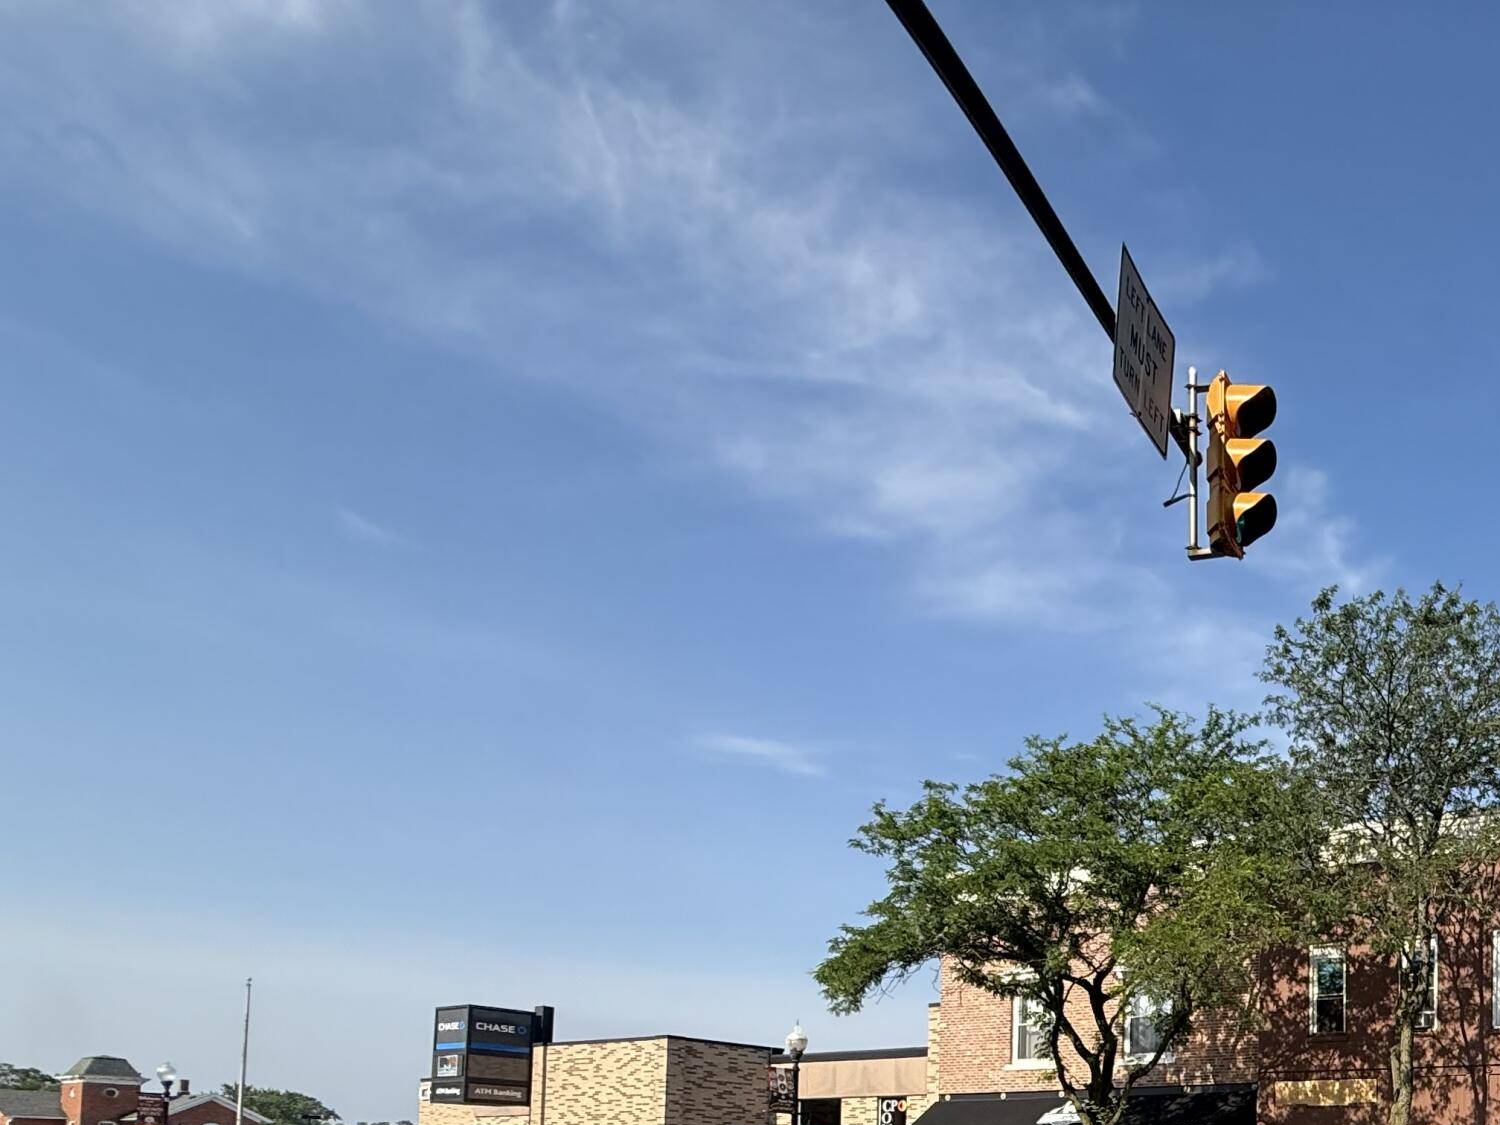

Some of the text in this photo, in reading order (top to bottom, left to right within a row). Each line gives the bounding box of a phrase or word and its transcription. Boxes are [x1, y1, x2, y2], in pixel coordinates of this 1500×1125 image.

[1126, 277, 1168, 363] LEFT LANE
[1130, 323, 1159, 385] MUST
[1119, 345, 1165, 433] TURN LEFT
[438, 1021, 460, 1031] CHASE
[475, 1021, 516, 1034] CHASE
[493, 1089, 522, 1098] Banking
